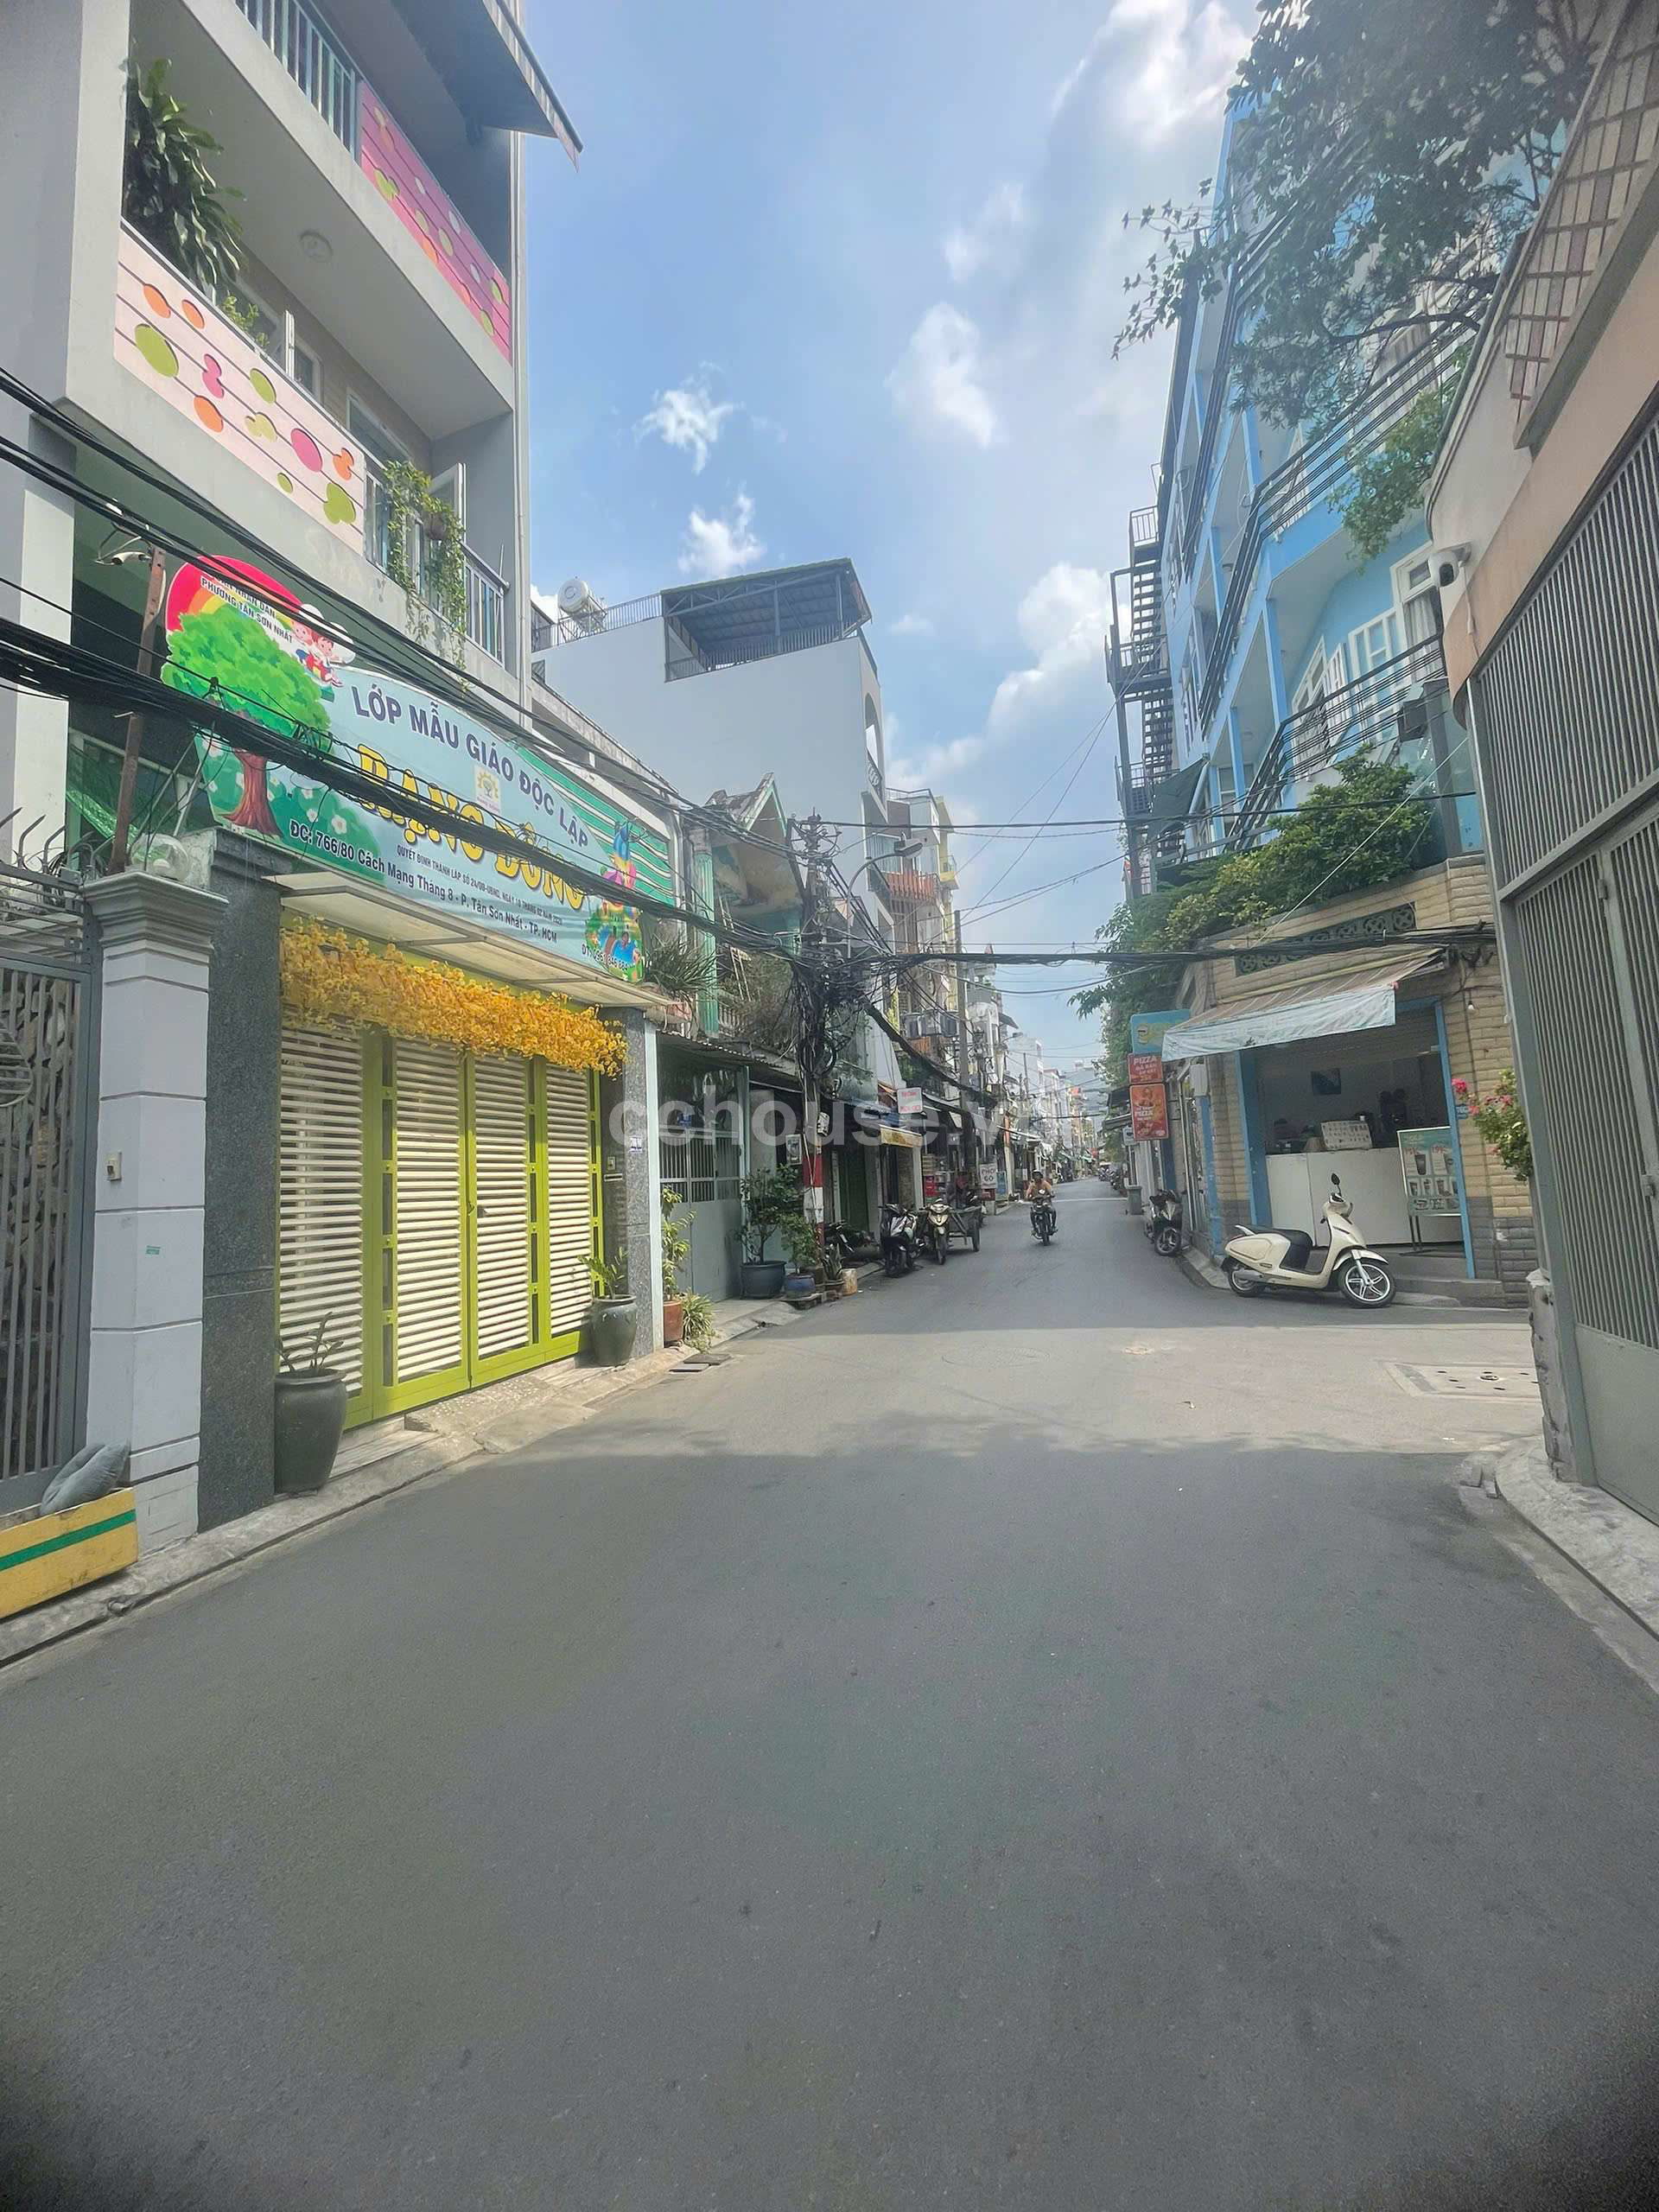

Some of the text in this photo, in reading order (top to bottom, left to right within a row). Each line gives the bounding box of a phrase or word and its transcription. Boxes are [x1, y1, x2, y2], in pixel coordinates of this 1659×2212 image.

[351, 683, 402, 724] LỚP
[409, 701, 460, 749] MẪU
[466, 734, 514, 782] GIÁO
[518, 770, 555, 817] ĐỘC
[559, 806, 588, 848] LẬP
[289, 821, 313, 844] ĐC:
[316, 831, 354, 861] 766/80
[358, 849, 385, 874] Cách
[387, 861, 415, 888] Mạng
[416, 874, 446, 901] Tháng
[448, 887, 454, 901] 8
[461, 893, 469, 908] P.
[471, 897, 487, 914] Tân
[489, 905, 504, 922] Sơn
[505, 912, 523, 931] Nhất
[529, 921, 541, 938] TP.
[542, 927, 557, 944] HCM
[1133, 1055, 1157, 1065] PIZZA
